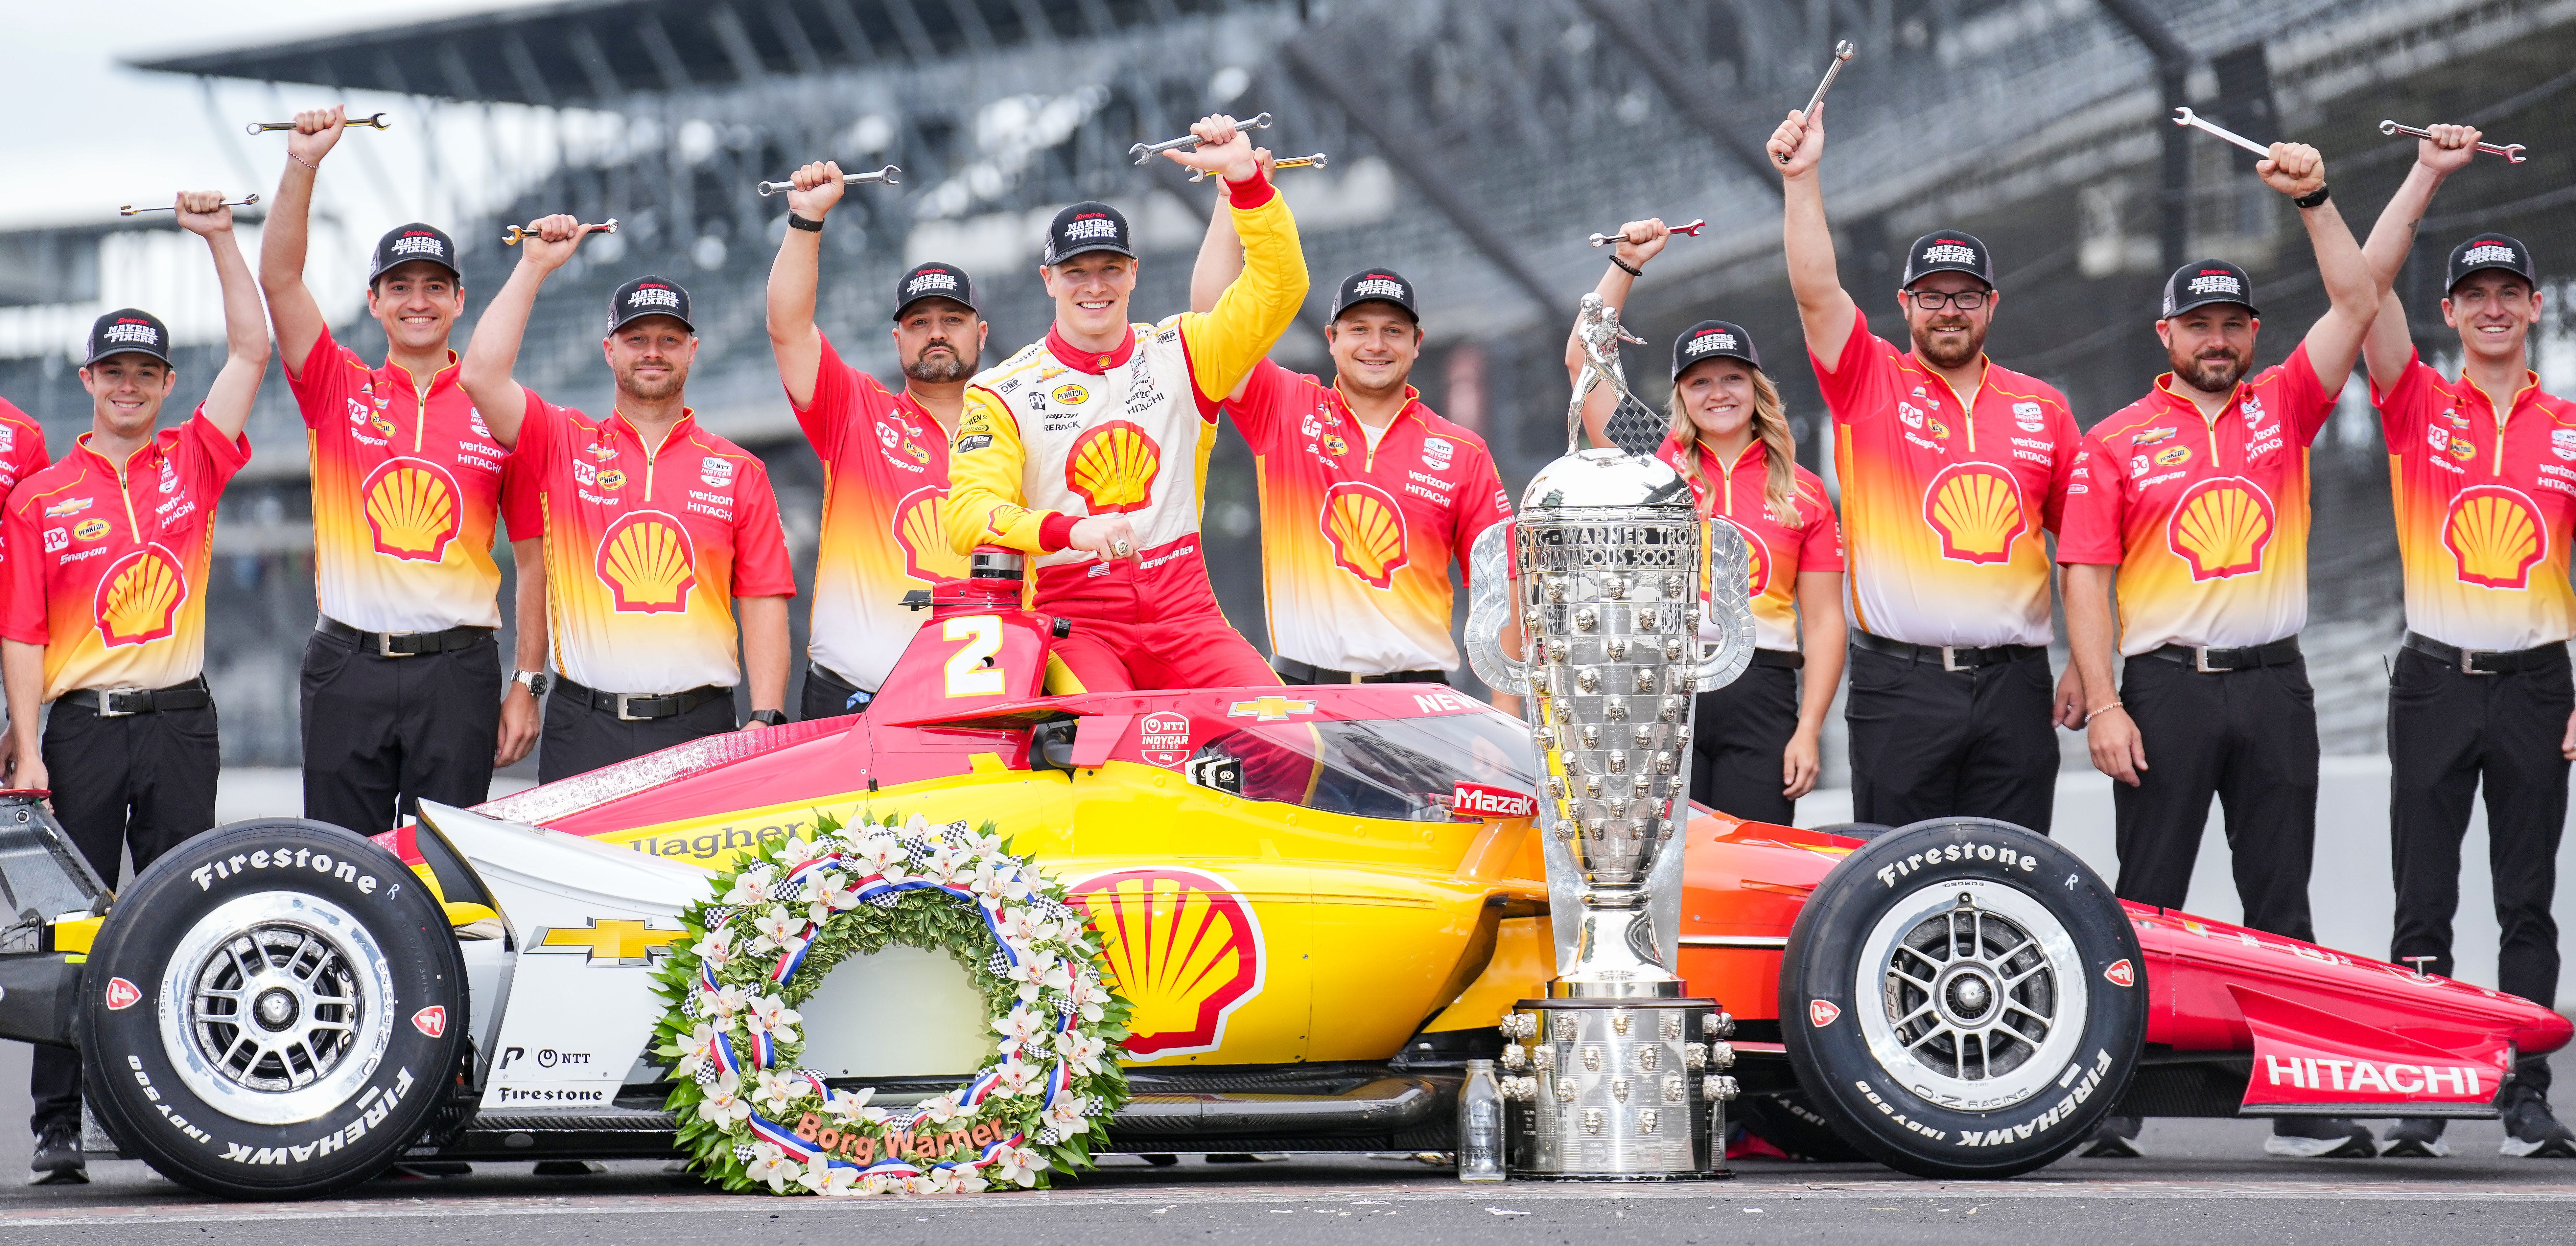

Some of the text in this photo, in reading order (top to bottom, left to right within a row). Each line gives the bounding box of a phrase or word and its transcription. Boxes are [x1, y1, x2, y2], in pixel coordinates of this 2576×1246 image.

[1067, 219, 1114, 232] MAKERS
[1071, 229, 1114, 241] FIXERS
[394, 237, 441, 248] MAKERS
[397, 245, 441, 256] FIXERS
[1927, 245, 1973, 256] MAKERS
[2465, 245, 2513, 257] MAKERS
[1929, 254, 1973, 264] FIXERS
[2468, 254, 2513, 265] FIXERS
[910, 274, 955, 287] MAKERS
[1357, 279, 1402, 291] MAKERS
[2192, 275, 2238, 286] MAKERS
[631, 289, 677, 300] MAKERS
[913, 281, 953, 295] FIXERS
[1360, 286, 1401, 300] FIXERS
[2195, 284, 2239, 295] FIXERS
[634, 297, 677, 308] FIXERS
[108, 324, 156, 335] MAKERS
[110, 334, 155, 344] FIXERS
[1688, 334, 1734, 349] MAKERS
[1692, 342, 1735, 356] FIXERS
[1001, 380, 1018, 392] OMP
[1031, 393, 1045, 409] PP
[1057, 389, 1085, 399] PENNZOIL
[1127, 392, 1164, 414] HITACHI
[961, 414, 987, 426] MENS
[1900, 405, 1922, 424] PPG
[1905, 431, 1945, 454] Snap-n
[2010, 437, 2051, 451] verizon
[2245, 424, 2280, 451] vizon
[459, 441, 501, 459] verizon
[1423, 447, 1452, 460] INDYCAR
[2160, 449, 2186, 463] PENNZOIL
[2247, 437, 2283, 463] HITACH
[458, 453, 502, 474] HITACHI
[2013, 449, 2052, 467] HITACHI
[574, 463, 595, 481] PPG
[701, 467, 732, 476] INDYCAR
[2131, 459, 2148, 476] PG
[600, 474, 623, 484] PENNZOIL
[1408, 470, 1451, 492] verizon
[689, 490, 734, 507] verizon
[1405, 483, 1451, 508] HITACHI
[687, 501, 733, 522] HITACHI
[78, 522, 106, 537] PENNZOIL
[44, 531, 67, 549] PPG
[1120, 543, 1128, 553] 500
[59, 546, 107, 566] Snap-on
[943, 614, 1006, 698] 2
[1163, 721, 1185, 730] NTT
[1142, 736, 1189, 745] INDYCAR
[1454, 787, 1533, 816] Mazak
[629, 821, 805, 859] llagher
[1878, 841, 2079, 890] Firestone R
[191, 847, 400, 900] Firestone R
[562, 1053, 590, 1063] NTT
[2265, 1055, 2480, 1095] HITACHI
[498, 1087, 603, 1102] Firestone
[1956, 1048, 2113, 1147] FIREHAWK
[1968, 1087, 2031, 1108] RACING
[219, 1066, 414, 1165] FIREHAWK
[796, 1111, 1004, 1166] Borg Warner
